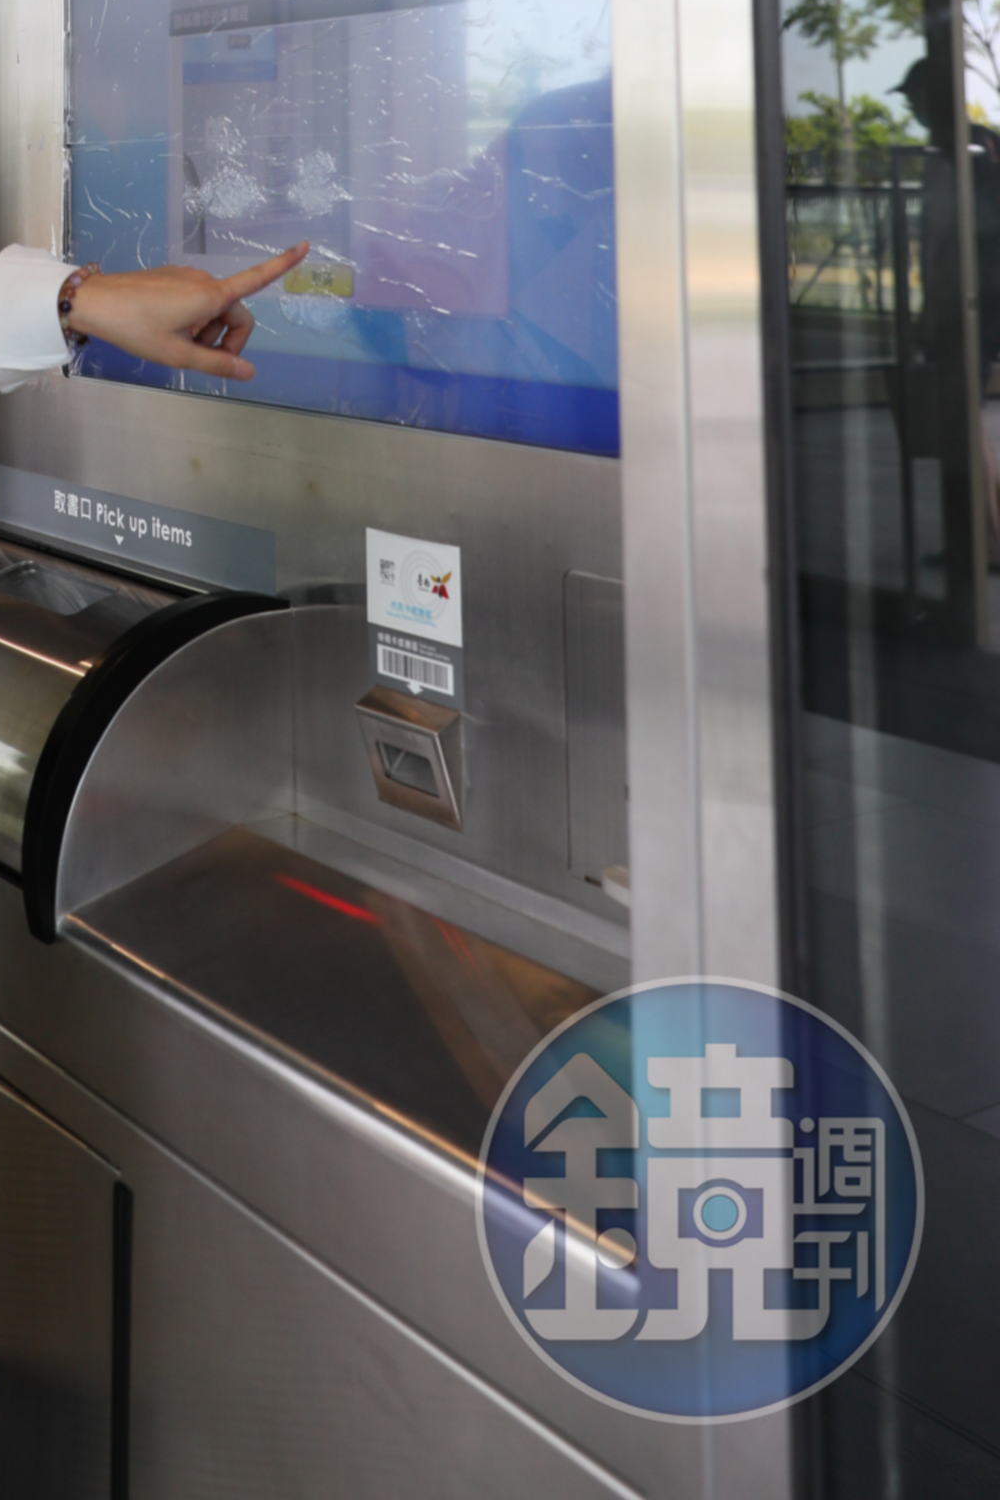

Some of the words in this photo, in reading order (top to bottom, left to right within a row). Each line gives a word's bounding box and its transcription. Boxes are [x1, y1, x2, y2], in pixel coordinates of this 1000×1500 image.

[53, 489, 92, 521] 取書口
[96, 502, 125, 530] Pick
[129, 515, 148, 539] up
[151, 516, 193, 548] items
